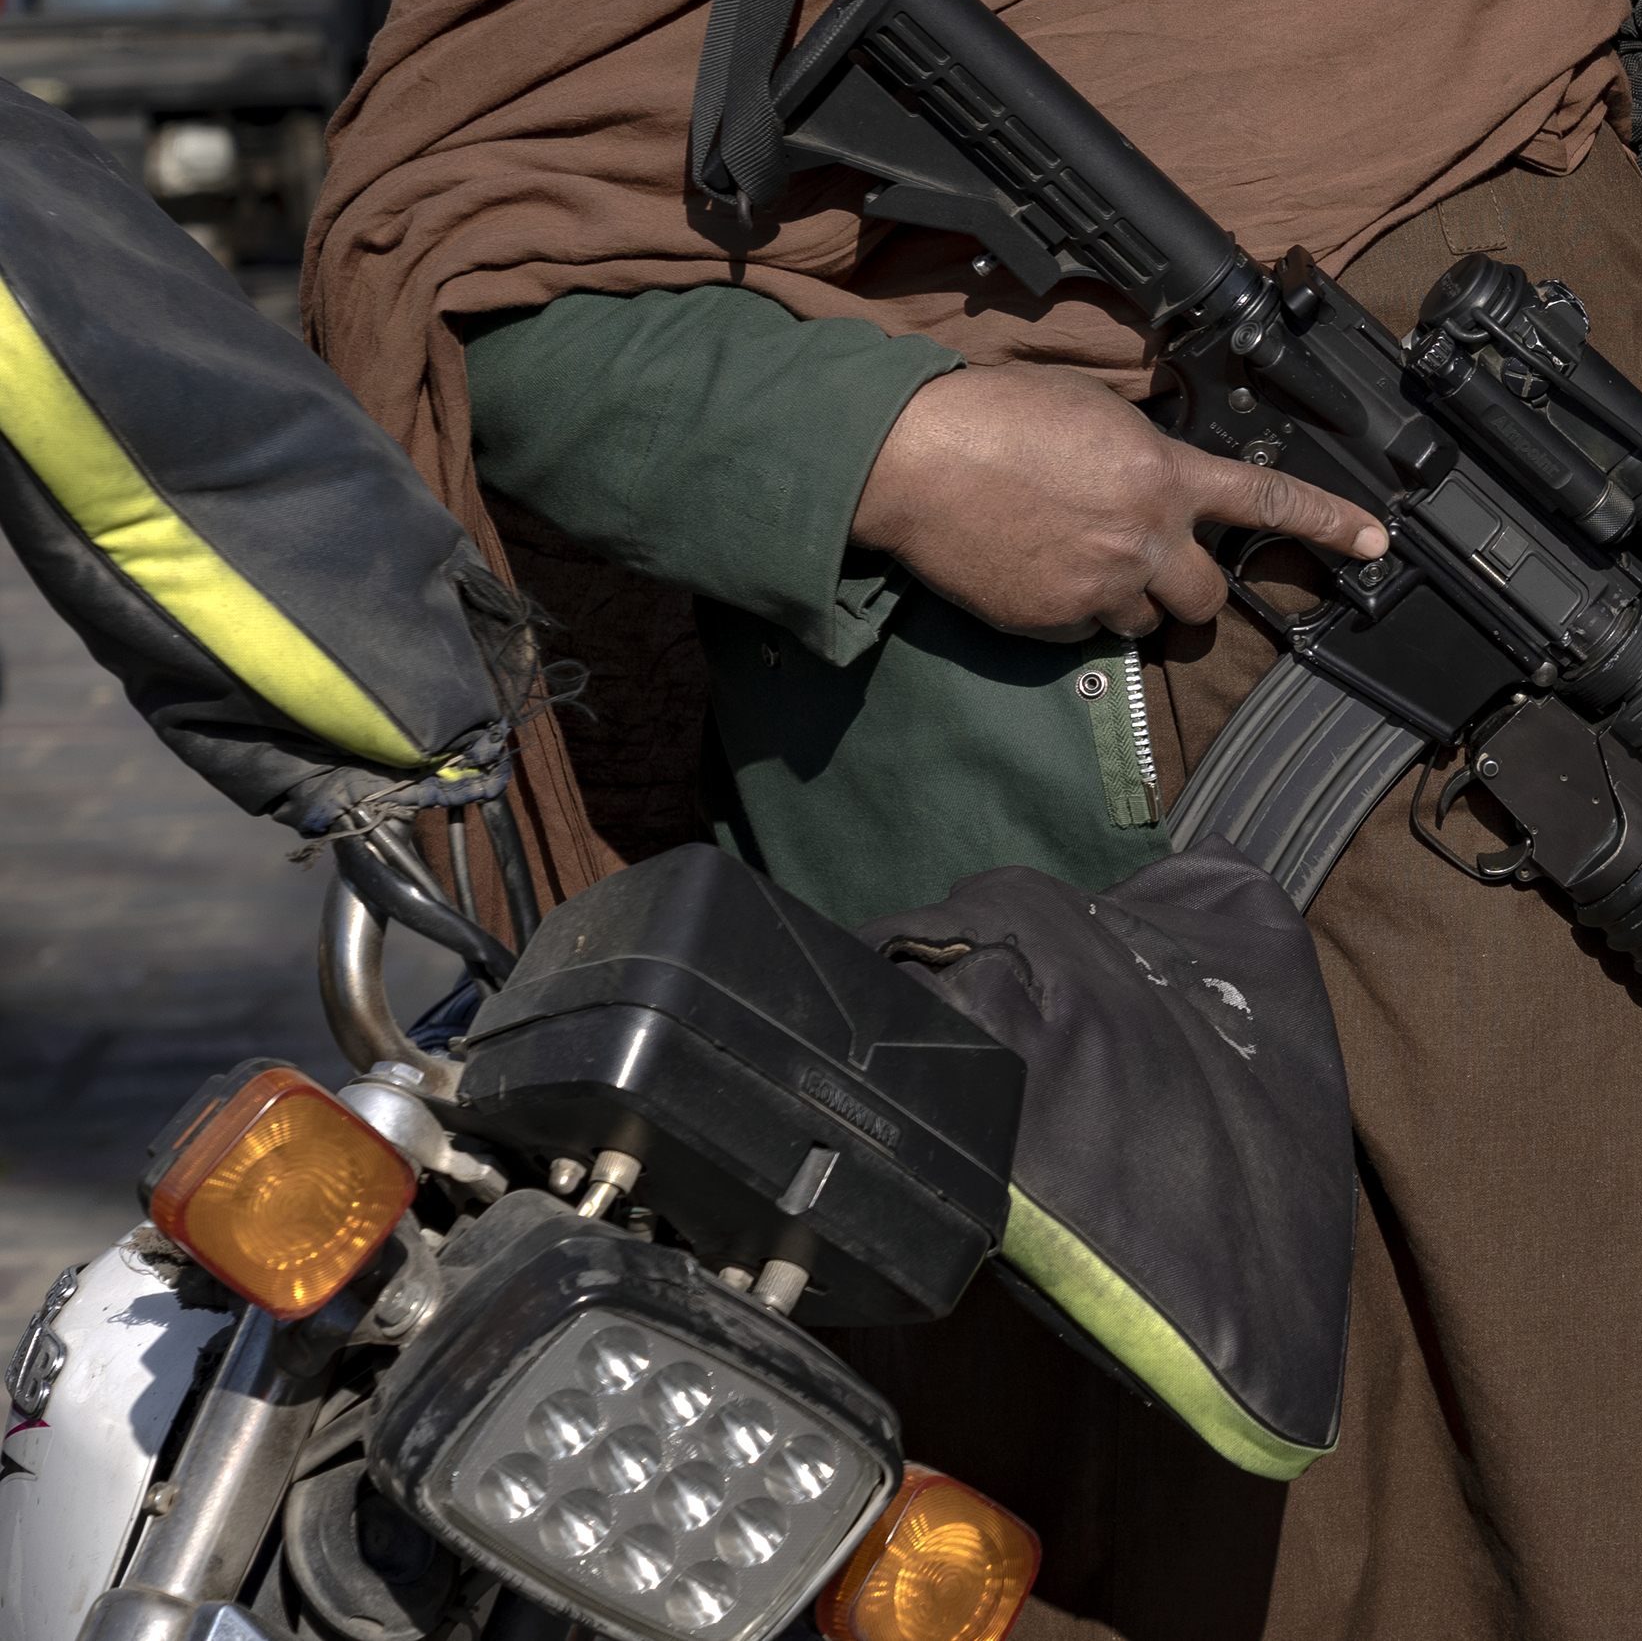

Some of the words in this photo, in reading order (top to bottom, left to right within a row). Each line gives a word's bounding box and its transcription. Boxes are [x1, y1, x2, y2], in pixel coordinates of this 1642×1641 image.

[1209, 421, 1240, 449] BURST
[1262, 427, 1288, 452] SEMI
[1489, 412, 1562, 480] Aimpoint
